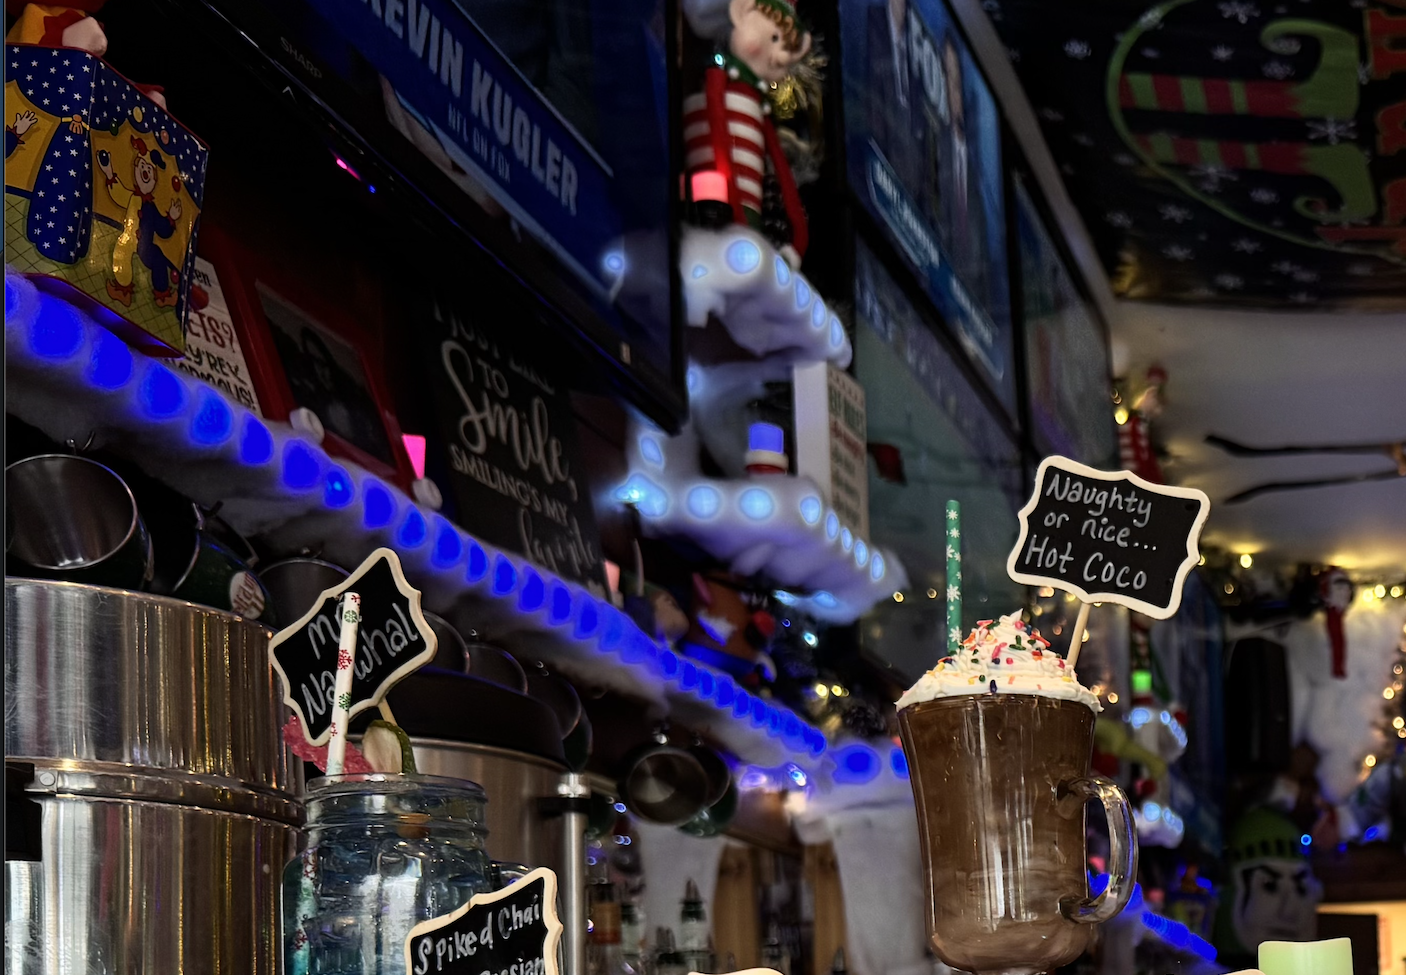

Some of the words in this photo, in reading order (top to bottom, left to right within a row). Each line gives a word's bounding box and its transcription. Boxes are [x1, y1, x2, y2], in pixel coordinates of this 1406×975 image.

[279, 36, 323, 80] SHARP
[448, 103, 469, 143] NFL
[470, 58, 579, 217] KUGLER
[475, 356, 510, 399] TO
[450, 443, 542, 513] SMILING'S
[543, 492, 568, 527] MY
[1046, 474, 1152, 527] Naughty
[1044, 512, 1069, 528] or
[1025, 534, 1074, 574] Hot
[1083, 552, 1147, 590] Coco
[301, 602, 419, 724] Nawhal
[414, 911, 494, 975] Spiked
[498, 894, 540, 940] Chai
